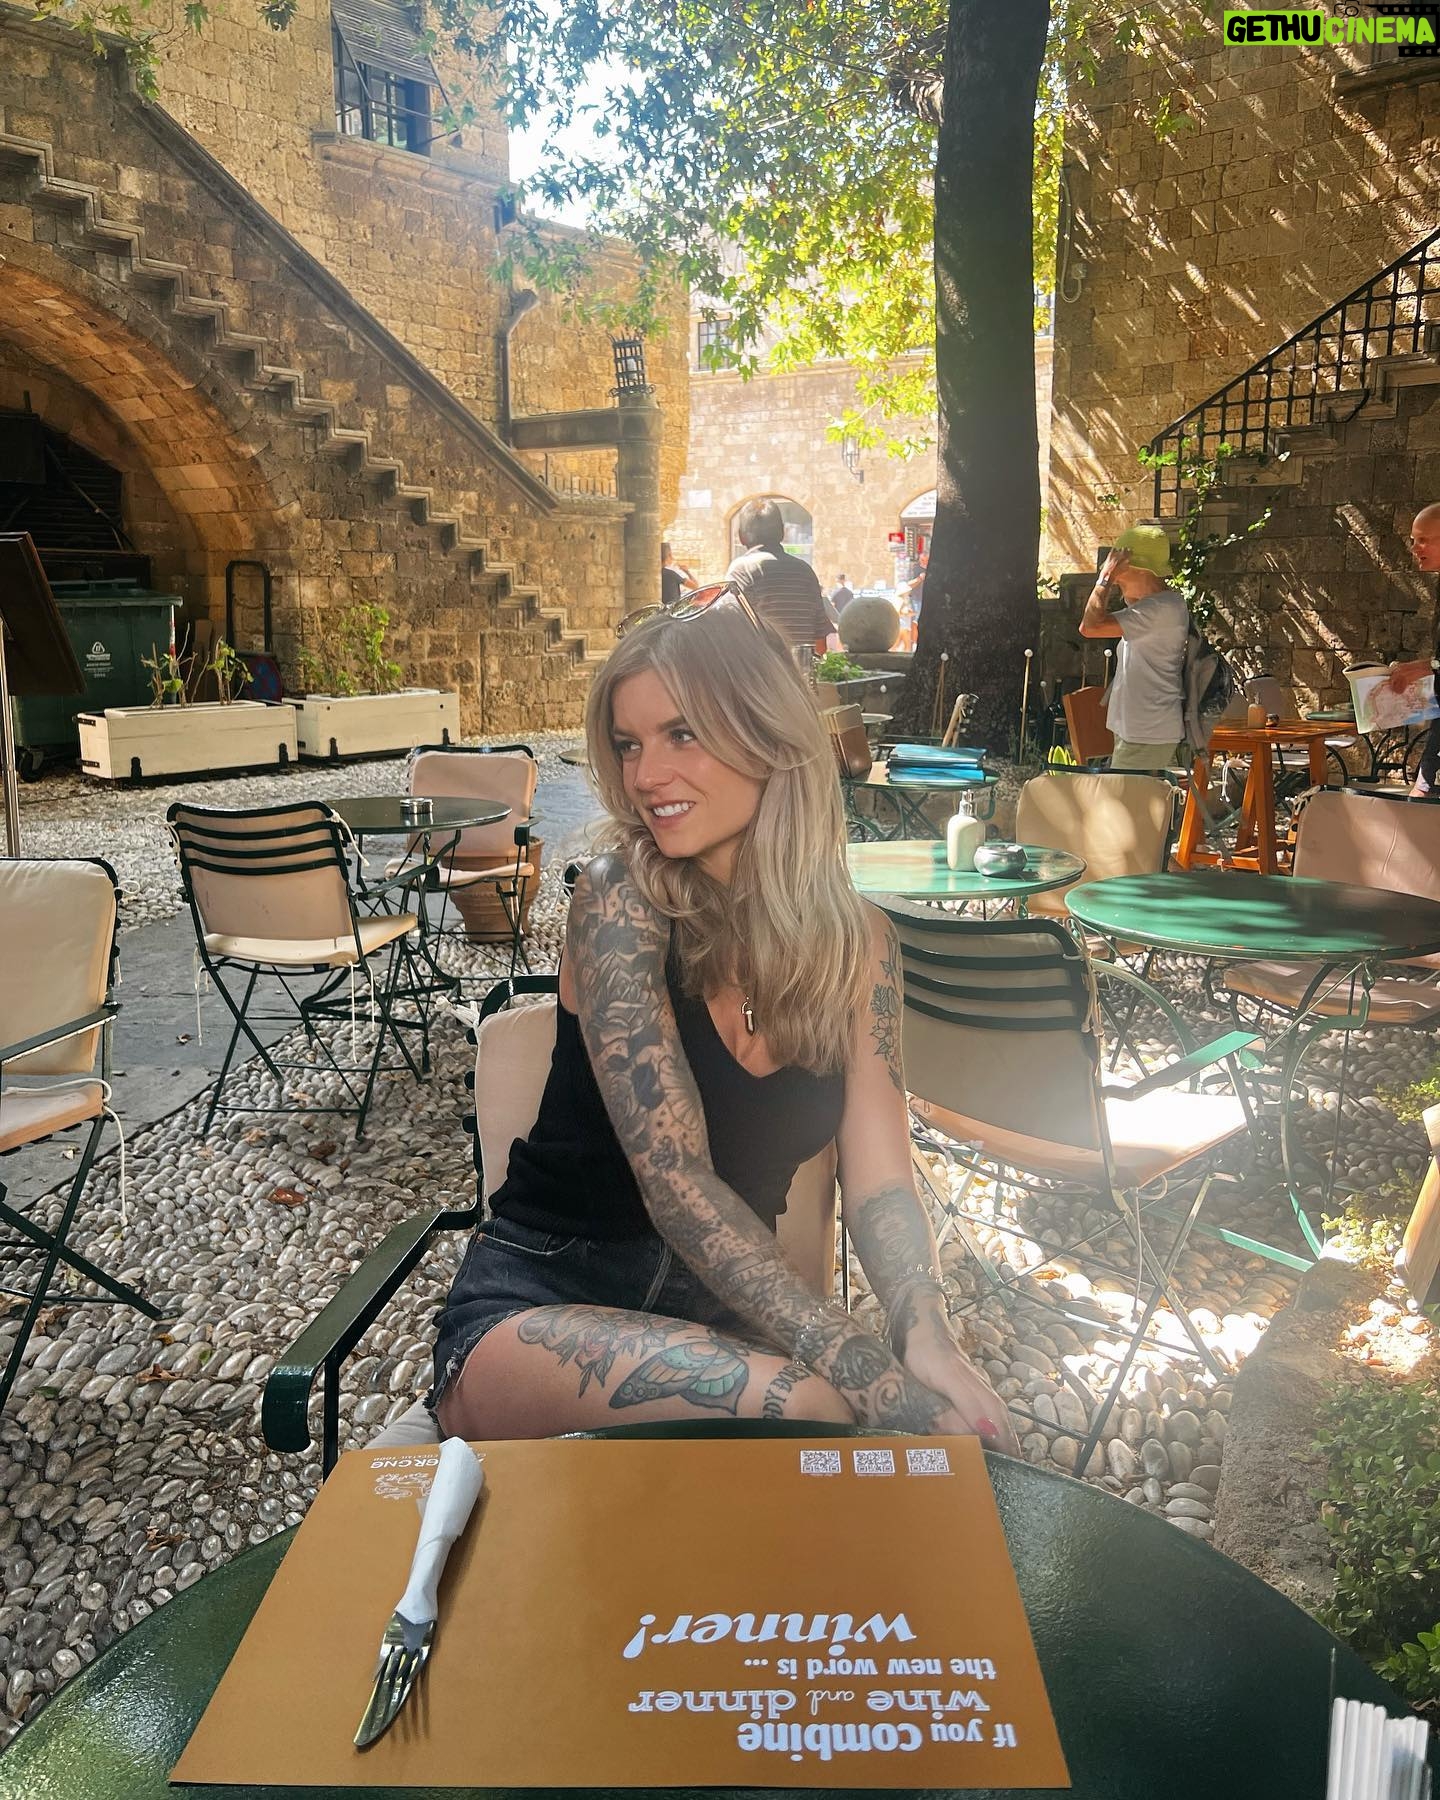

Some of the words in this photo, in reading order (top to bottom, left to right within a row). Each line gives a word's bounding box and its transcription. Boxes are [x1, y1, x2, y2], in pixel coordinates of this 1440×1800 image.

[622, 1612, 918, 1659] winner!
[776, 1658, 798, 1680] is
[806, 1658, 879, 1680] word
[886, 1658, 943, 1676] new
[949, 1657, 998, 1681] the
[627, 1689, 797, 1720] dinner
[805, 1689, 856, 1716] and
[866, 1689, 991, 1721] wine
[736, 1722, 924, 1762] combine
[929, 1717, 984, 1742] you
[992, 1723, 1018, 1748] If
